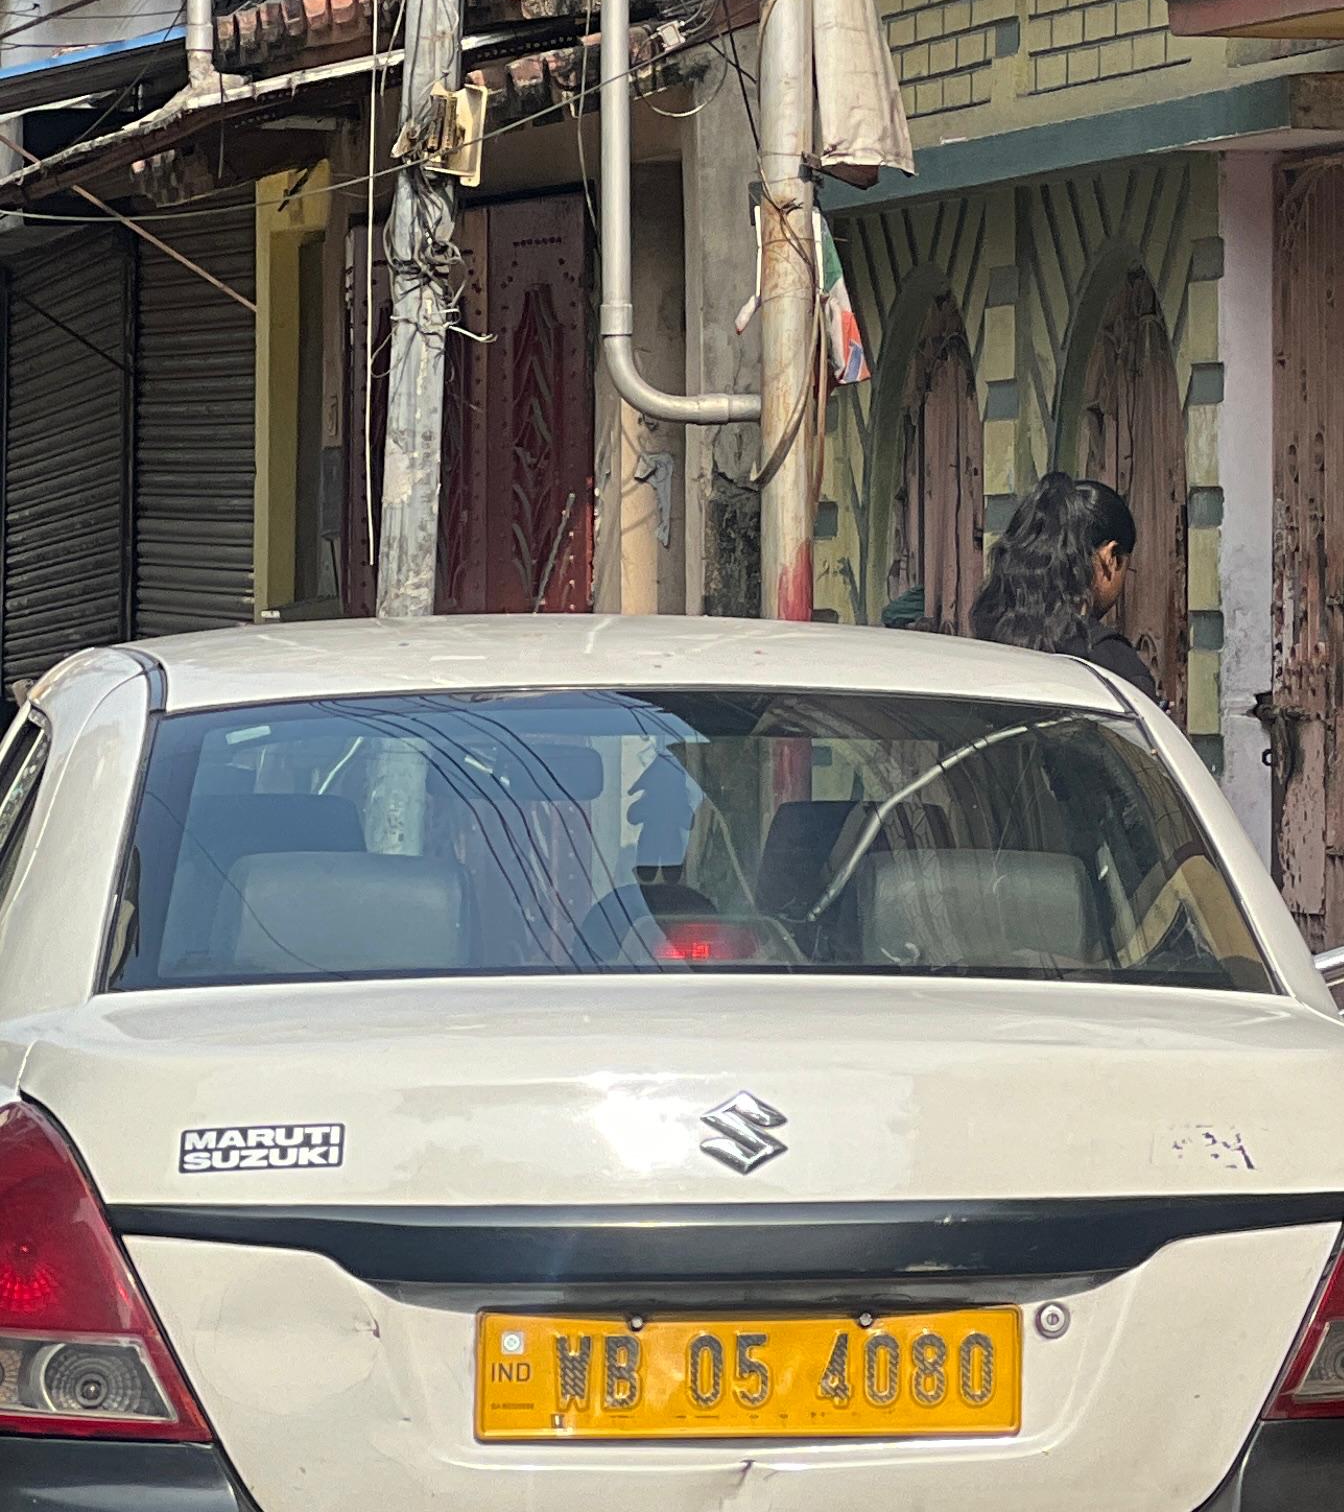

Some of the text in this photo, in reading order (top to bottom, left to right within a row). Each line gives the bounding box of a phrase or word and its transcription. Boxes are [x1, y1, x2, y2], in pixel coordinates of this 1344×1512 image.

[184, 1125, 341, 1150] MARUTI
[182, 1146, 340, 1171] SUZUKI
[491, 1362, 531, 1382] IND
[554, 1331, 996, 1410] WB 05 4080
